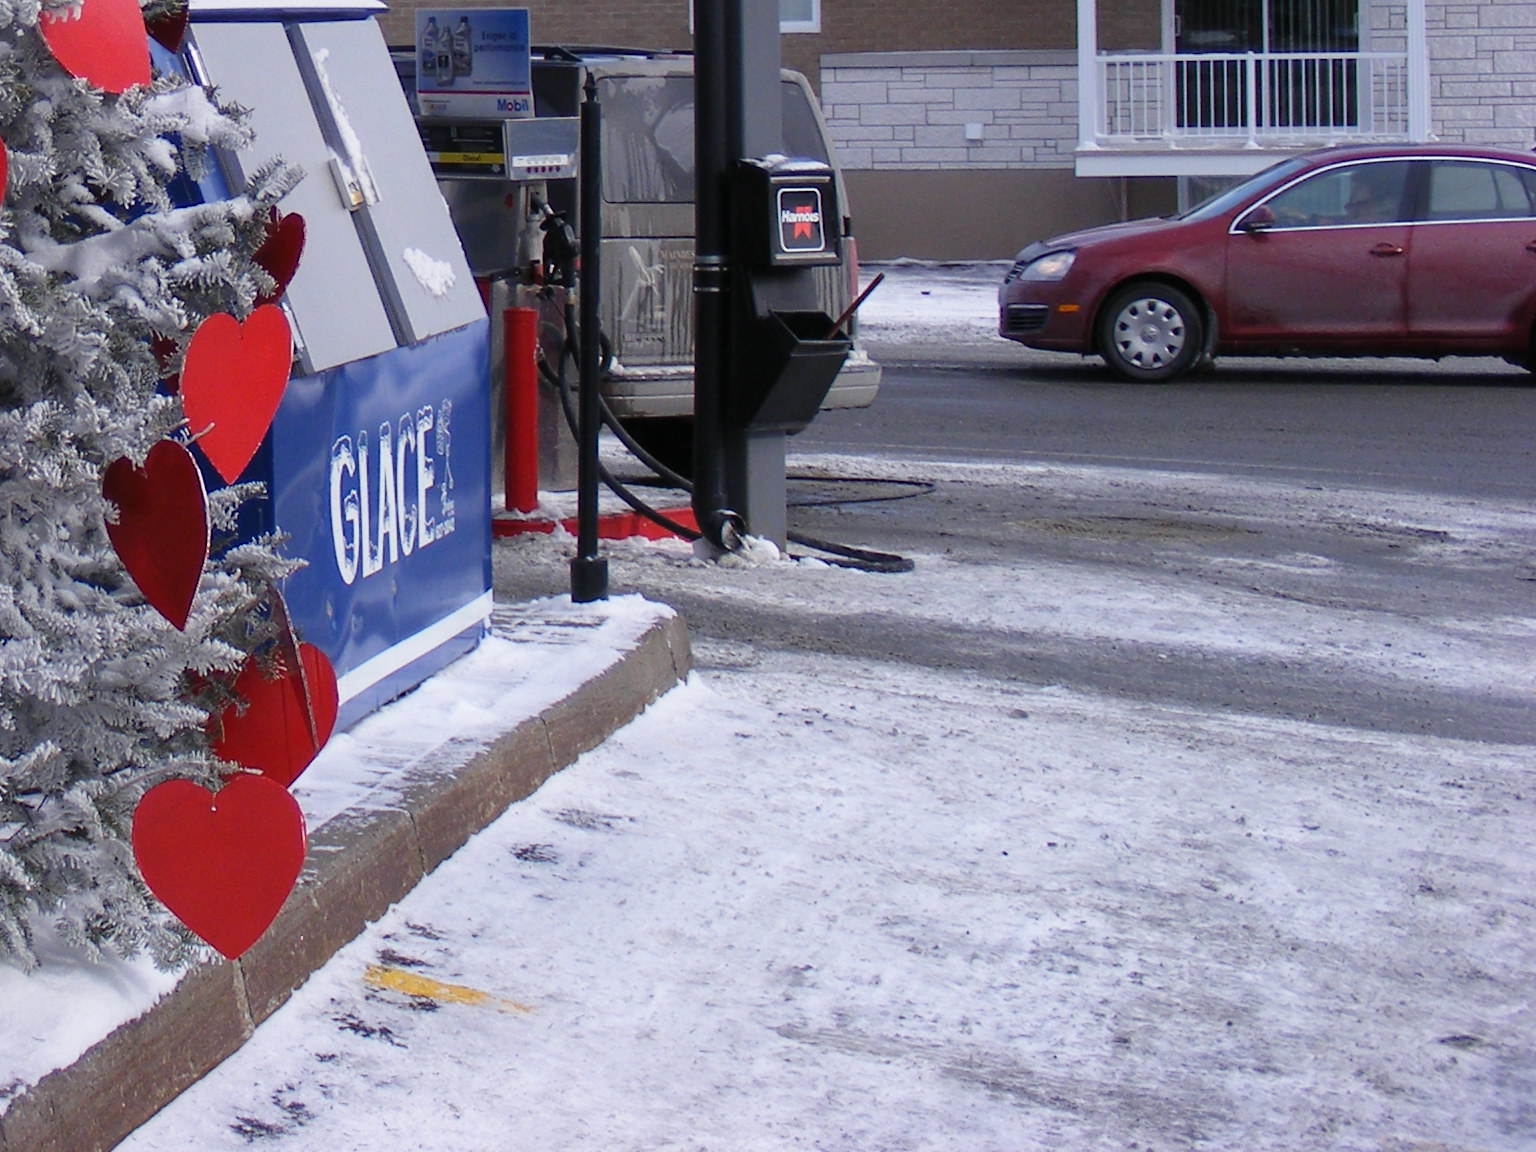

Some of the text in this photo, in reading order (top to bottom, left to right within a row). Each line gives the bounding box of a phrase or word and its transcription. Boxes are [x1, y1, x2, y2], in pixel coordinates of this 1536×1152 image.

[497, 98, 529, 112] Mobil
[781, 209, 820, 224] Harnois
[330, 404, 435, 585] GLACE
